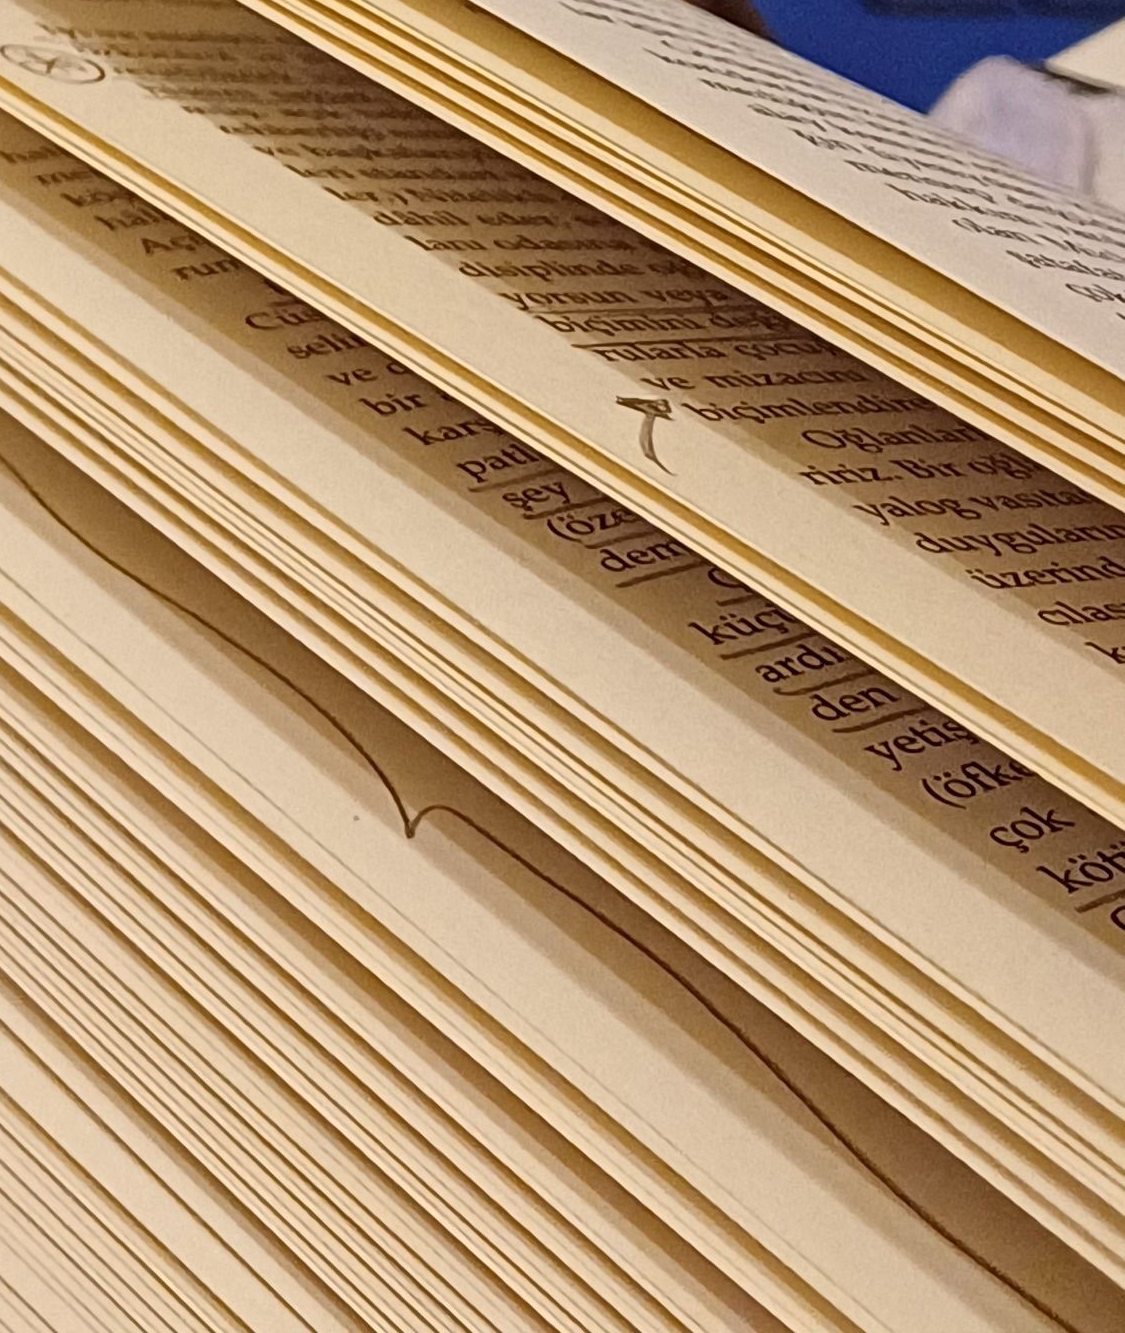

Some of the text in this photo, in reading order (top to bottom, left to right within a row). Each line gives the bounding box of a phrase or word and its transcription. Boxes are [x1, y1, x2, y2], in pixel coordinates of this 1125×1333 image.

[324, 368, 379, 387] ve
[639, 372, 696, 391] ve
[358, 393, 428, 417] bir
[888, 458, 969, 480] Bir
[501, 481, 571, 513] şey
[852, 495, 983, 527] yalog
[810, 686, 902, 722] den
[989, 806, 1076, 854] çok
